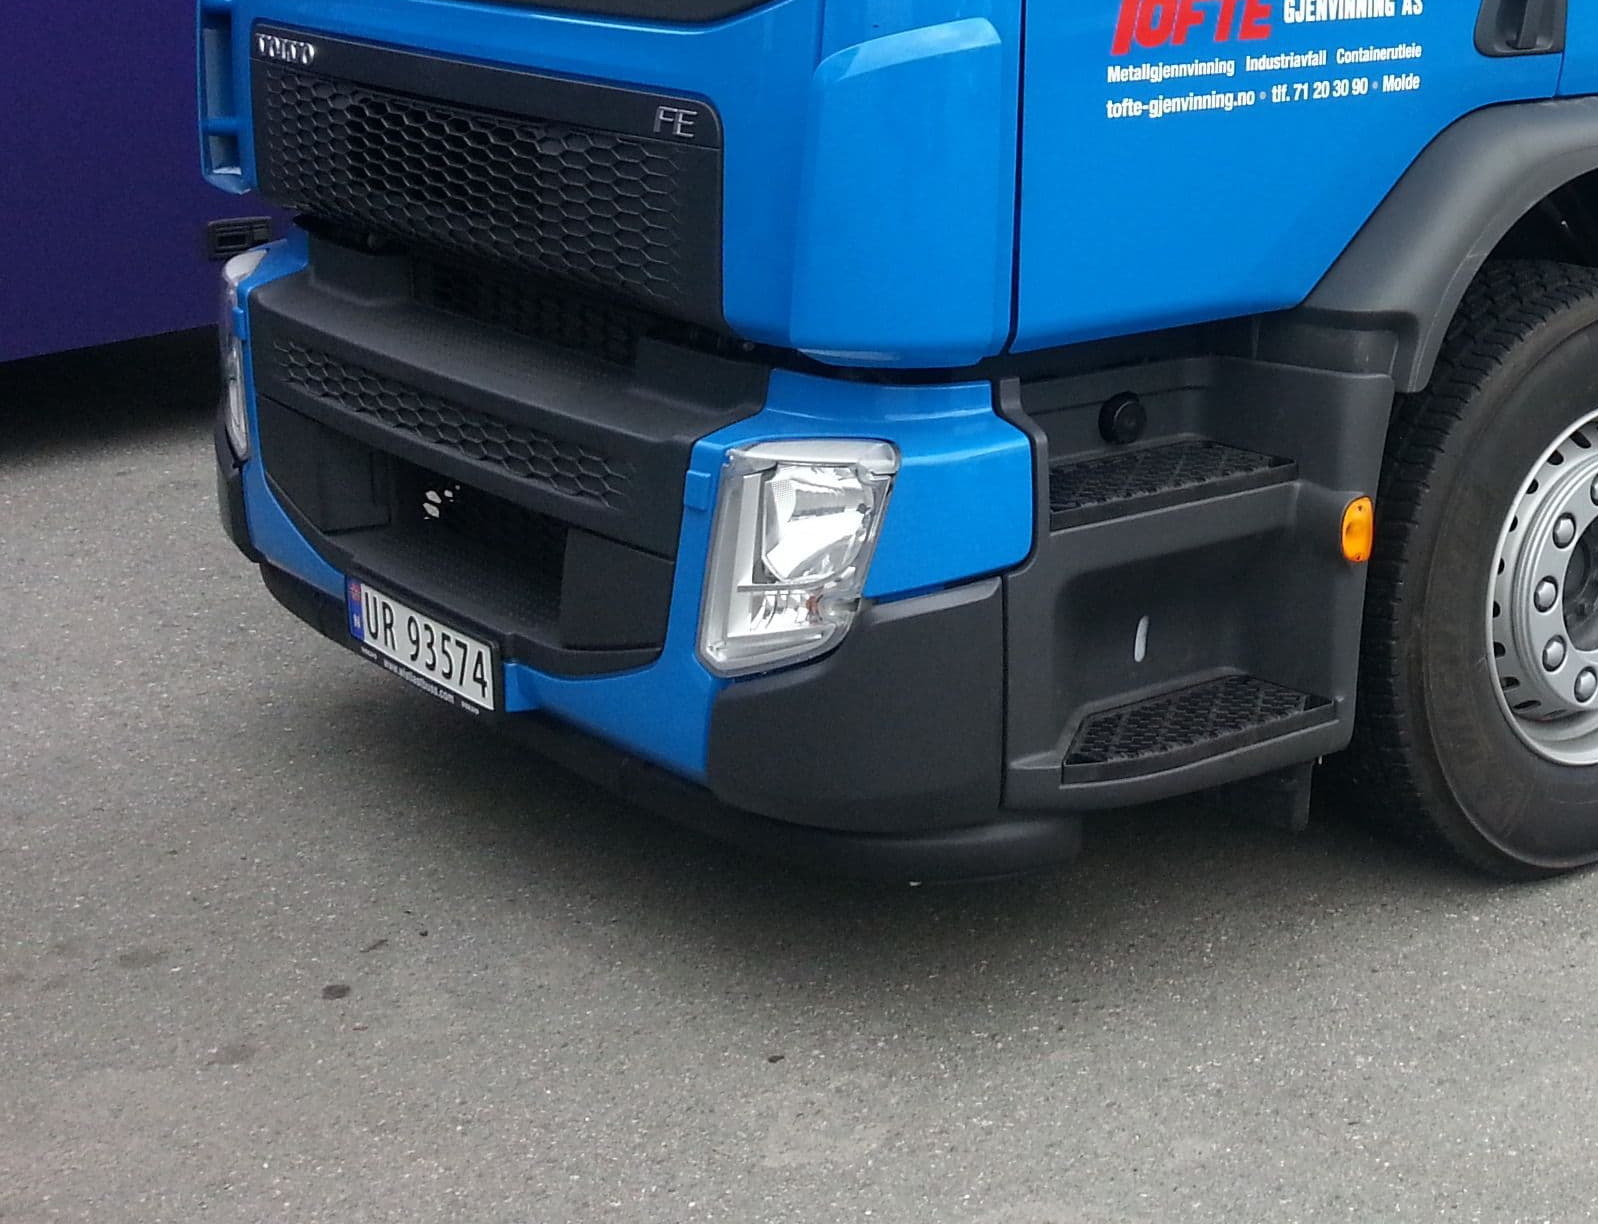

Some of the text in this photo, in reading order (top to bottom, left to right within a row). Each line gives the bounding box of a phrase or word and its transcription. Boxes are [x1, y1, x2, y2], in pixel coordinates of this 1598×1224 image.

[255, 33, 316, 65] VOLVO
[1107, 42, 1422, 84] Metallgjennvinning Industriavfall Containerutleie
[1106, 90, 1256, 120] tofte-gjenvinning.no
[1293, 83, 1309, 101] 71
[1312, 82, 1331, 99] 20
[1333, 79, 1350, 97] 30
[1352, 78, 1369, 95] 90
[1382, 73, 1421, 93] Molde
[653, 106, 698, 138] FE
[364, 591, 488, 699] UR 93574
